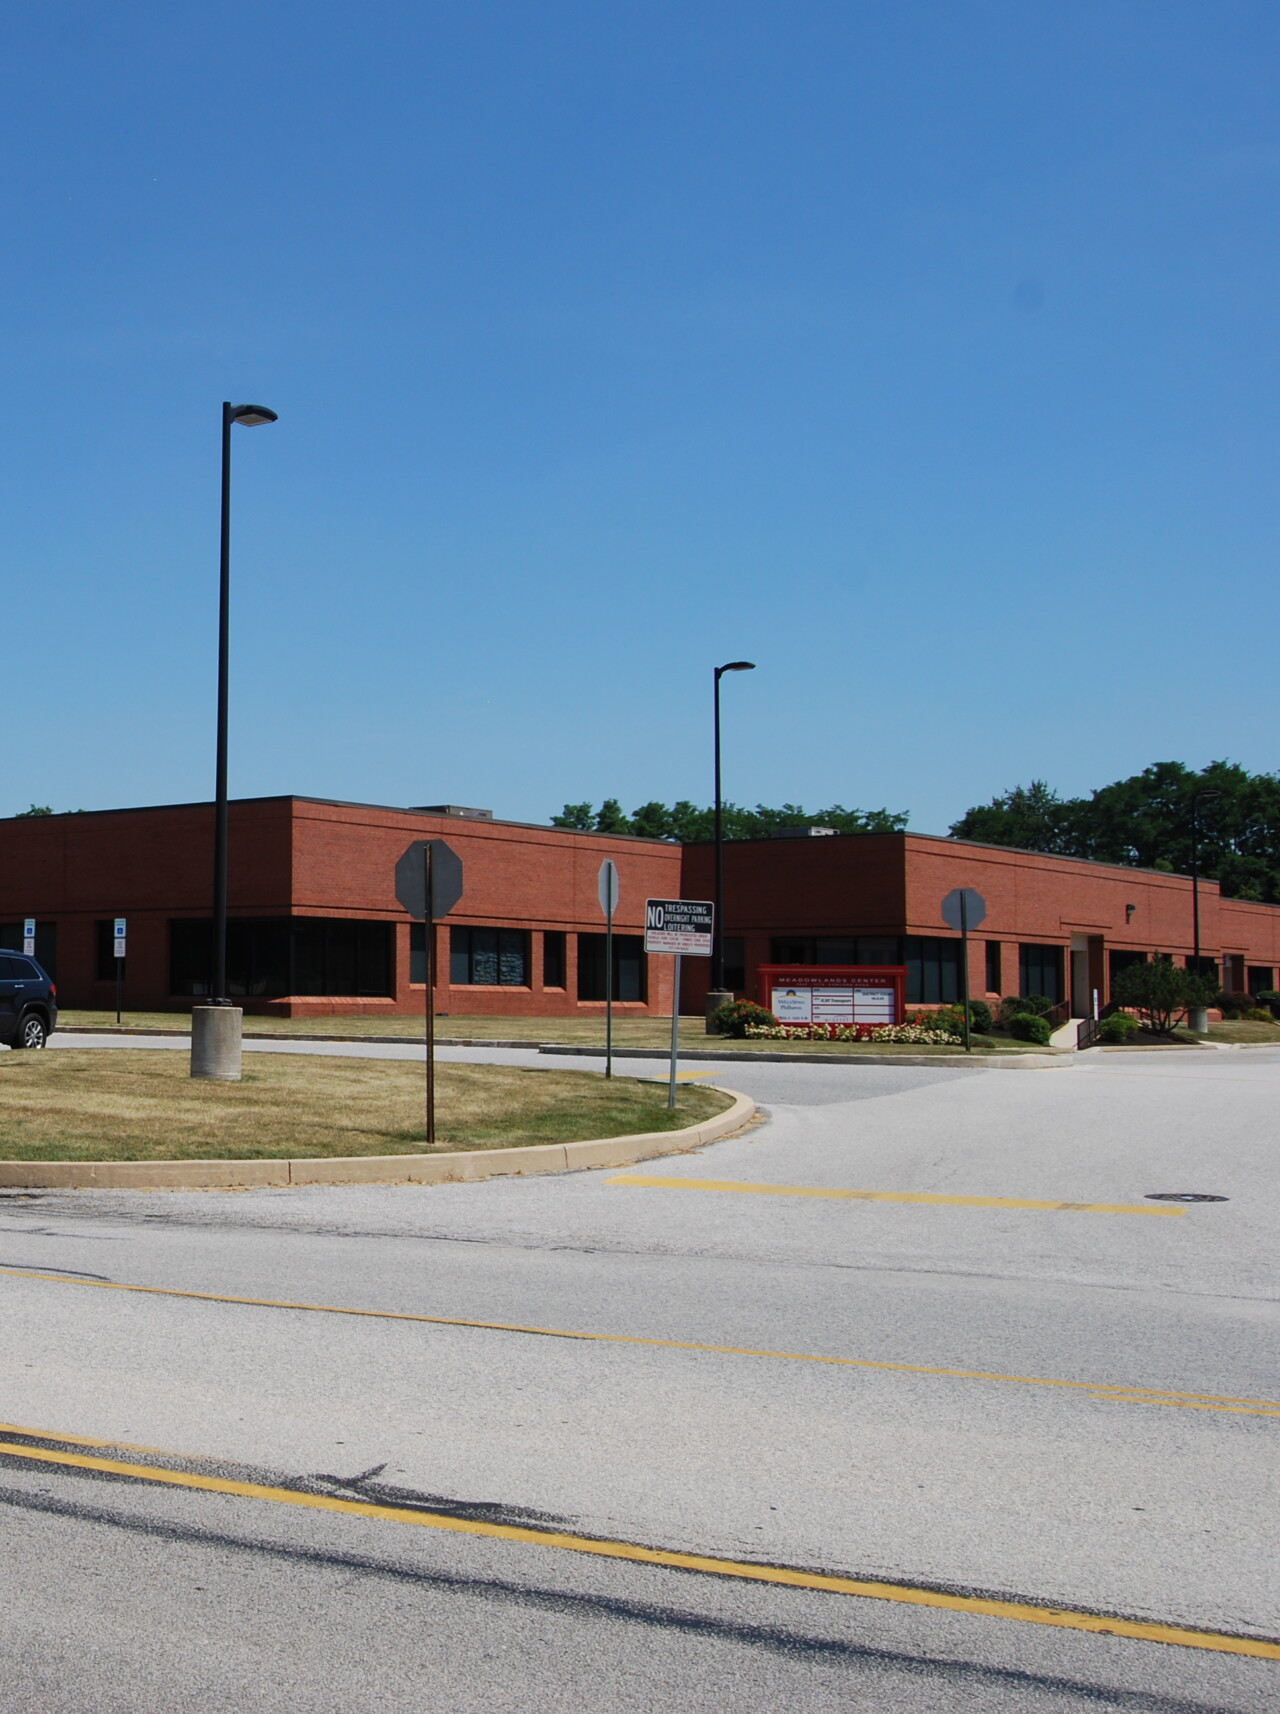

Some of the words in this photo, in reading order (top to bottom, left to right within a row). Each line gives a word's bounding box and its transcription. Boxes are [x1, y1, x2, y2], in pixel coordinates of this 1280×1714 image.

[665, 904, 707, 914] TRESPASSING
[647, 906, 664, 928] NO
[665, 913, 690, 922] OVERNIGHT
[691, 915, 711, 924] PARKING
[664, 923, 695, 933] LOITERING
